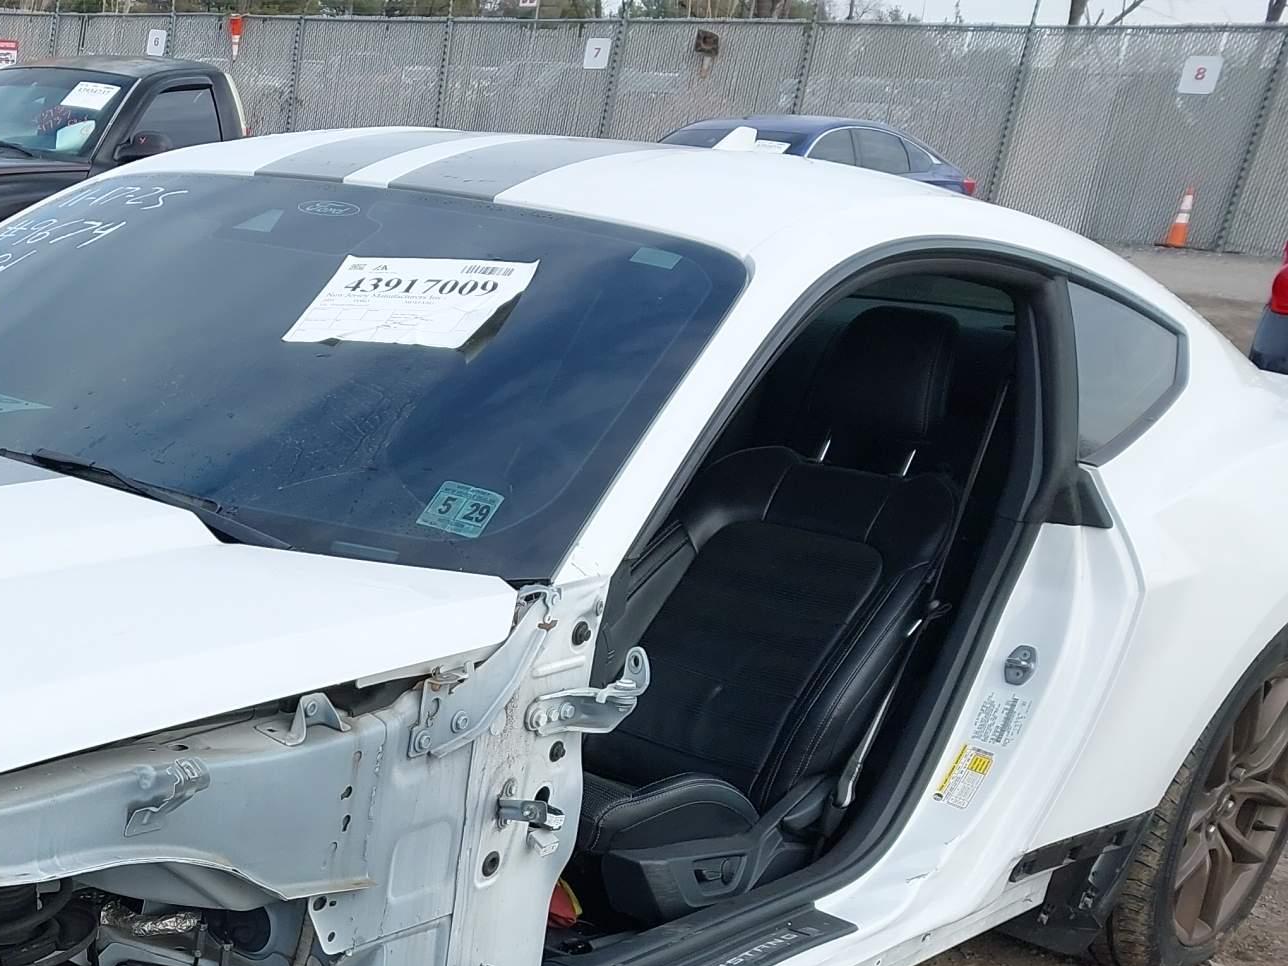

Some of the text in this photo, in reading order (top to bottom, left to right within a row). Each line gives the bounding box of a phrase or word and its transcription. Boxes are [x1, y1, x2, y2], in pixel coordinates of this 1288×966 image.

[154, 37, 160, 46] 6
[594, 47, 601, 58] 7
[1194, 67, 1207, 80] 8
[58, 186, 189, 210] 11-17-25
[306, 203, 351, 214] Ford
[344, 276, 499, 297] 43917009
[438, 496, 457, 515] 5
[462, 502, 491, 522] 29
